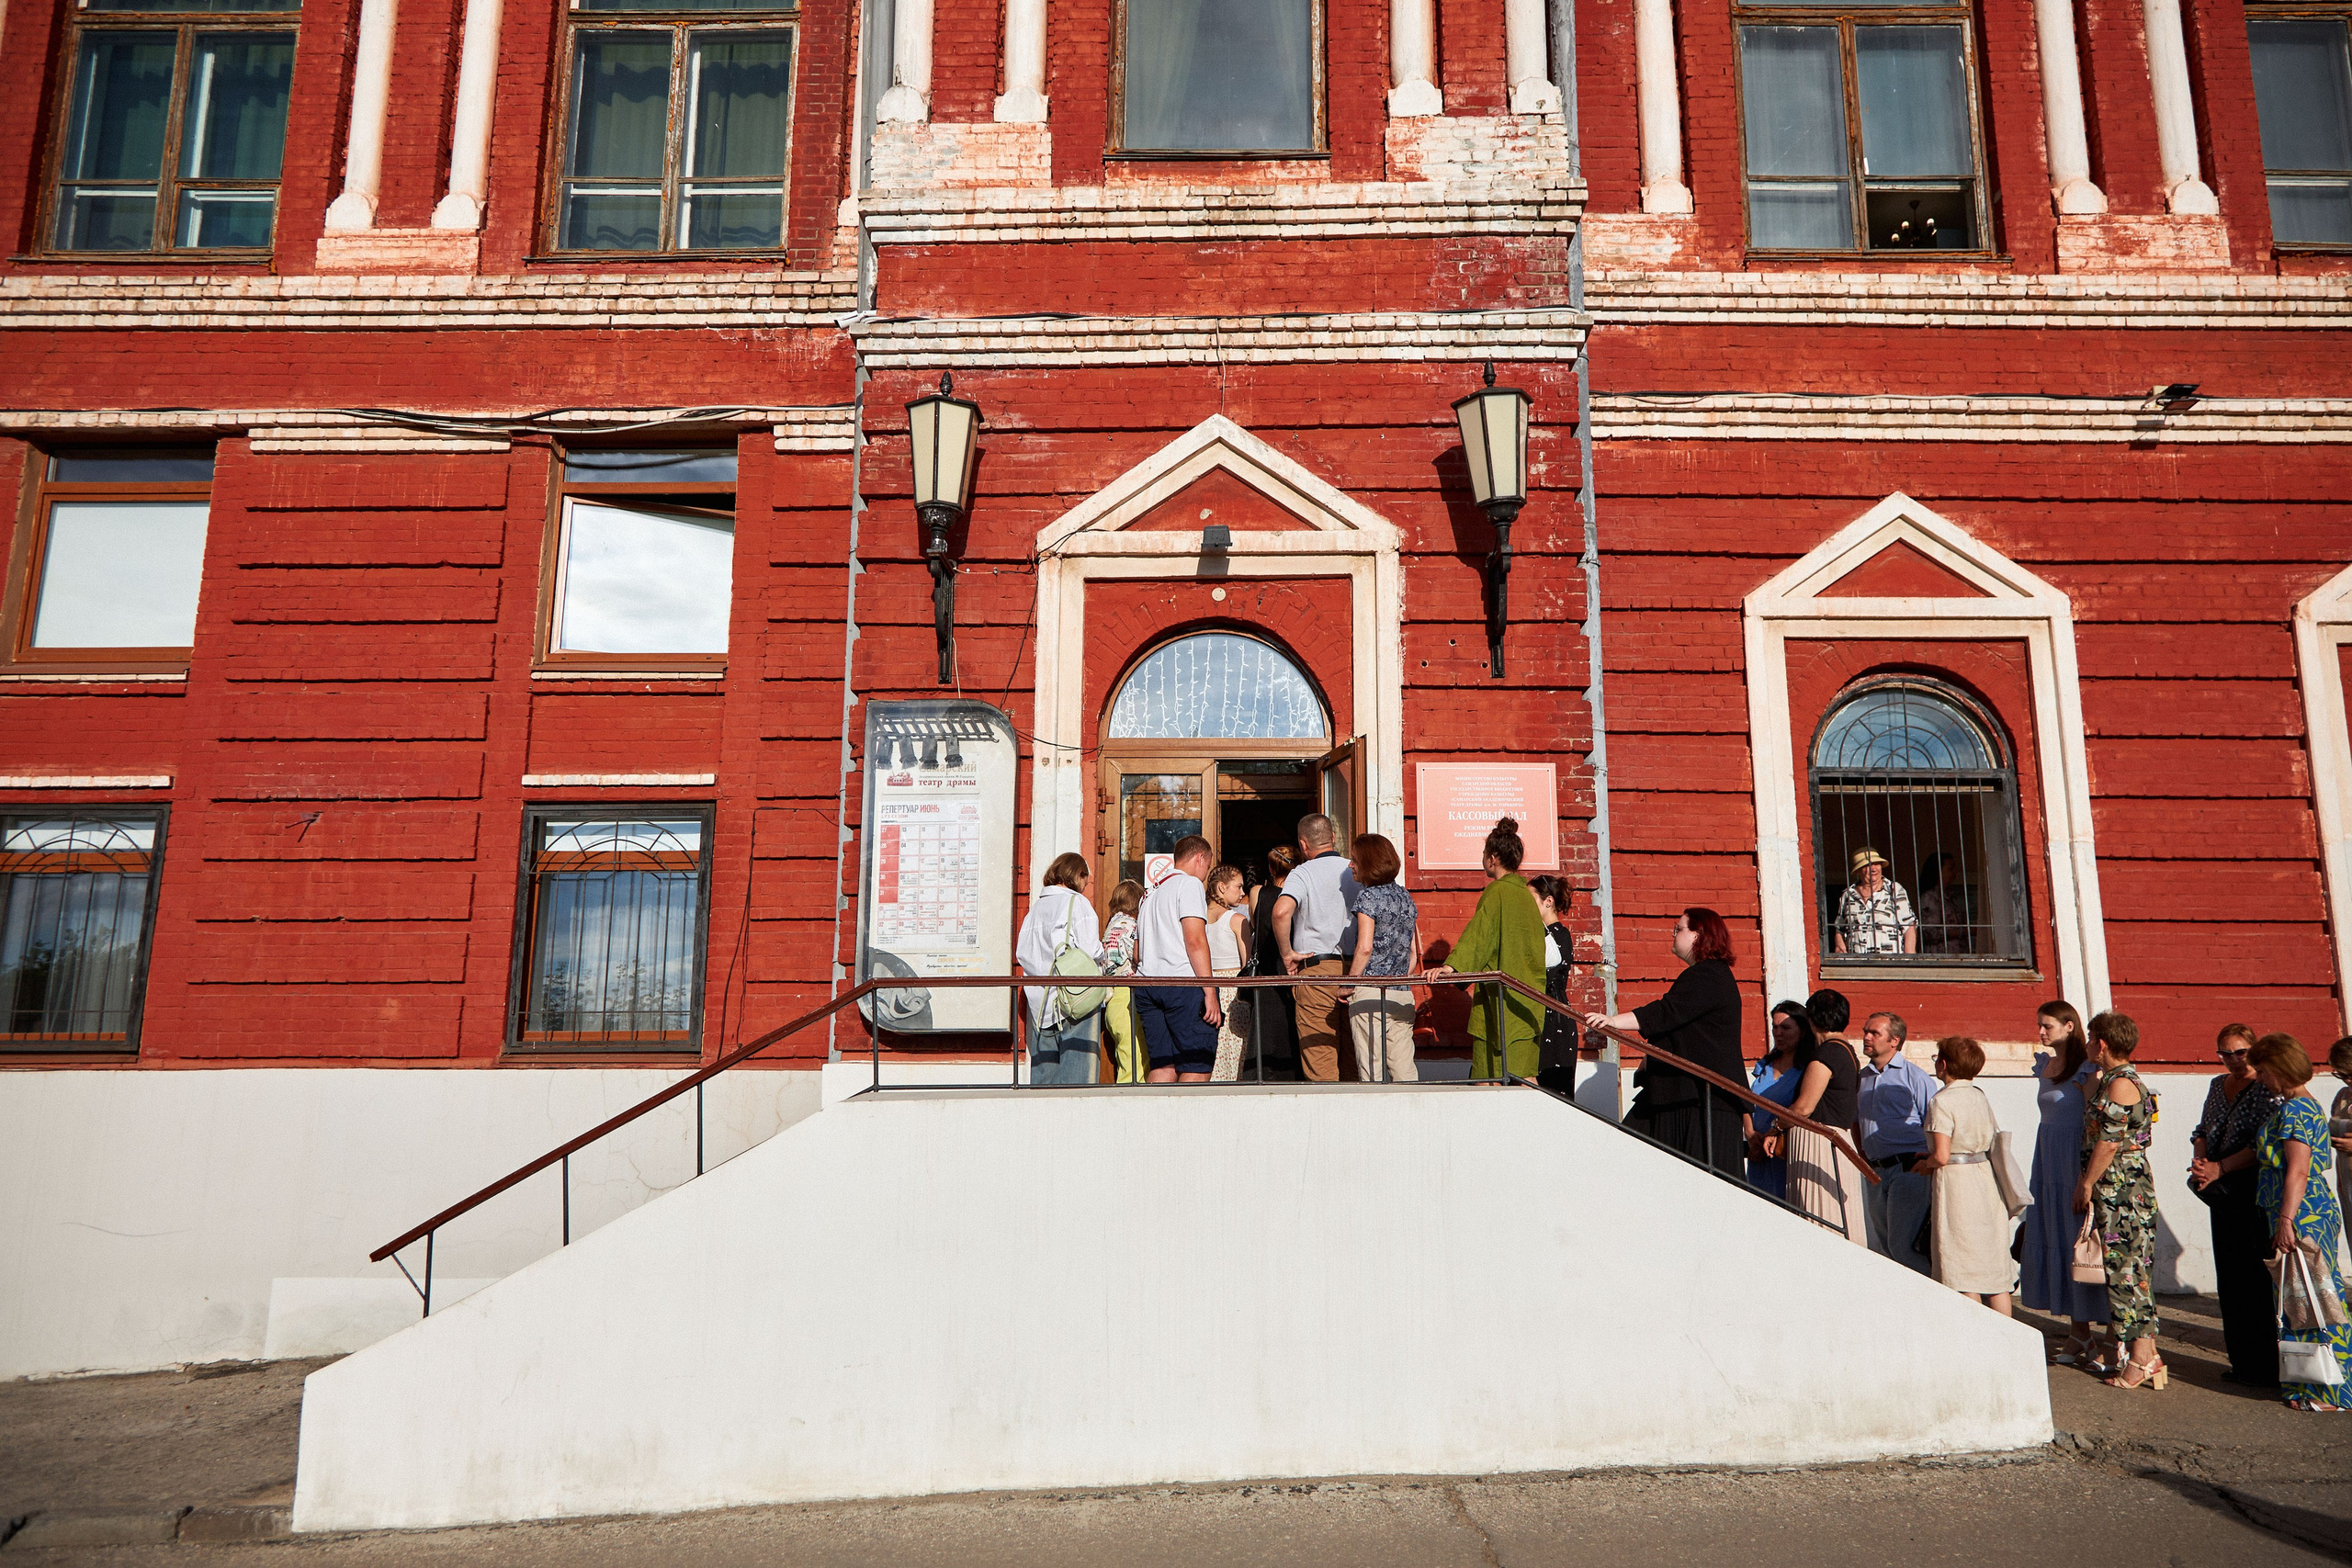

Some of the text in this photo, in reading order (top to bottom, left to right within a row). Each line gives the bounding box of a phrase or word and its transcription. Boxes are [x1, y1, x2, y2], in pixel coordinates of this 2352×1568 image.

[881, 804, 940, 813] РЕПЕРТУАР ИЮНЬ
[1449, 809, 1505, 820] КАССОВЫЙ
